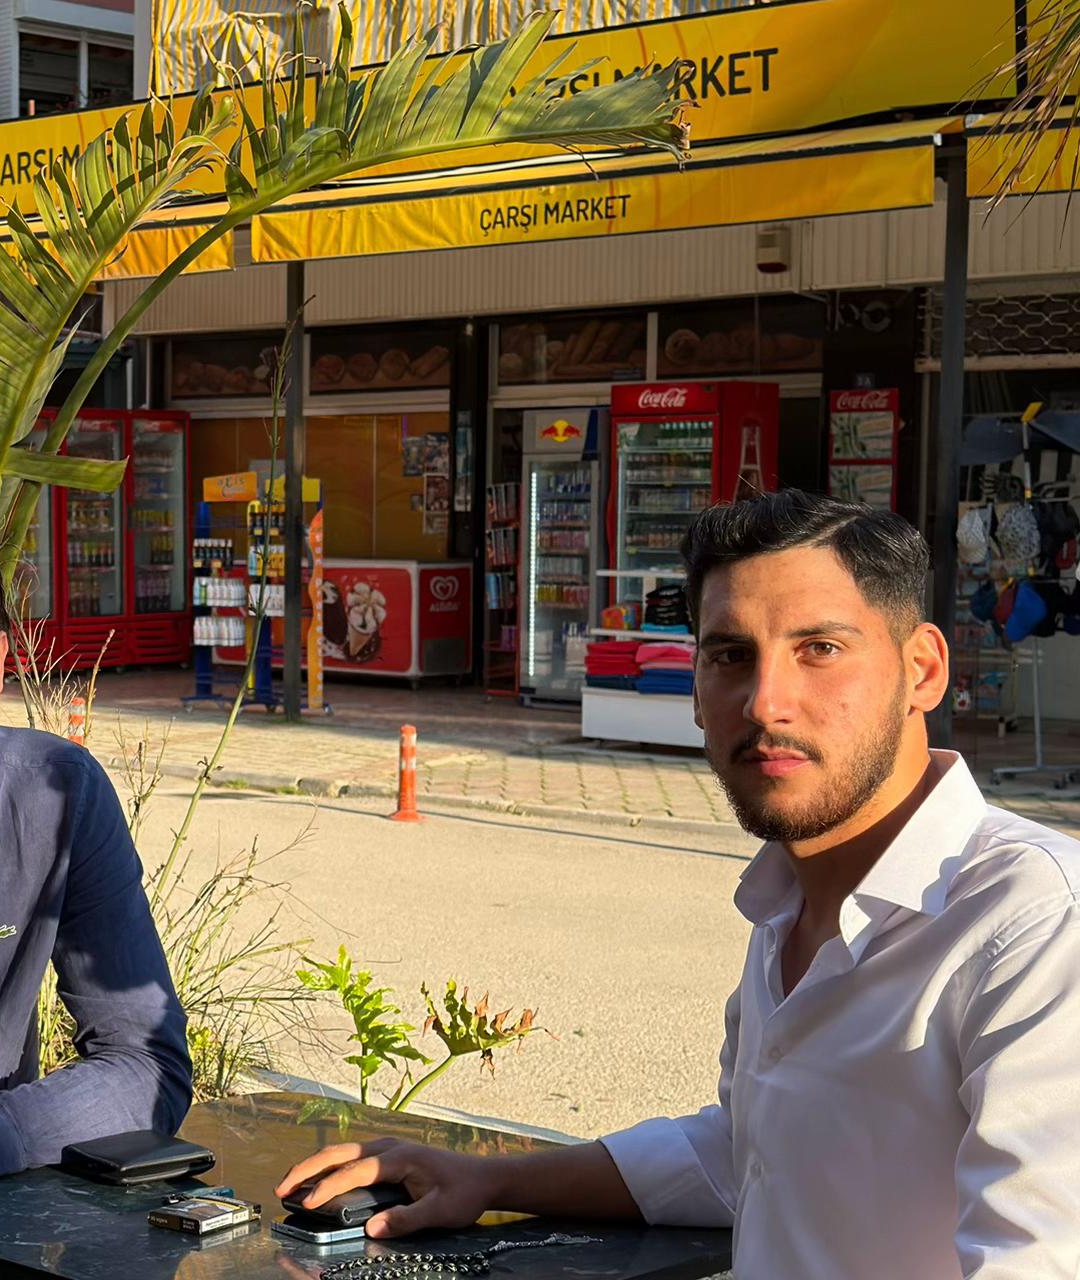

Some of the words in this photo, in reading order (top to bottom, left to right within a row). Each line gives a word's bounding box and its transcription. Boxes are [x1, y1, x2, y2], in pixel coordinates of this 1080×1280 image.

[613, 47, 779, 105] RKET
[479, 203, 538, 237] ÇARŞI
[543, 194, 632, 225] MARKET
